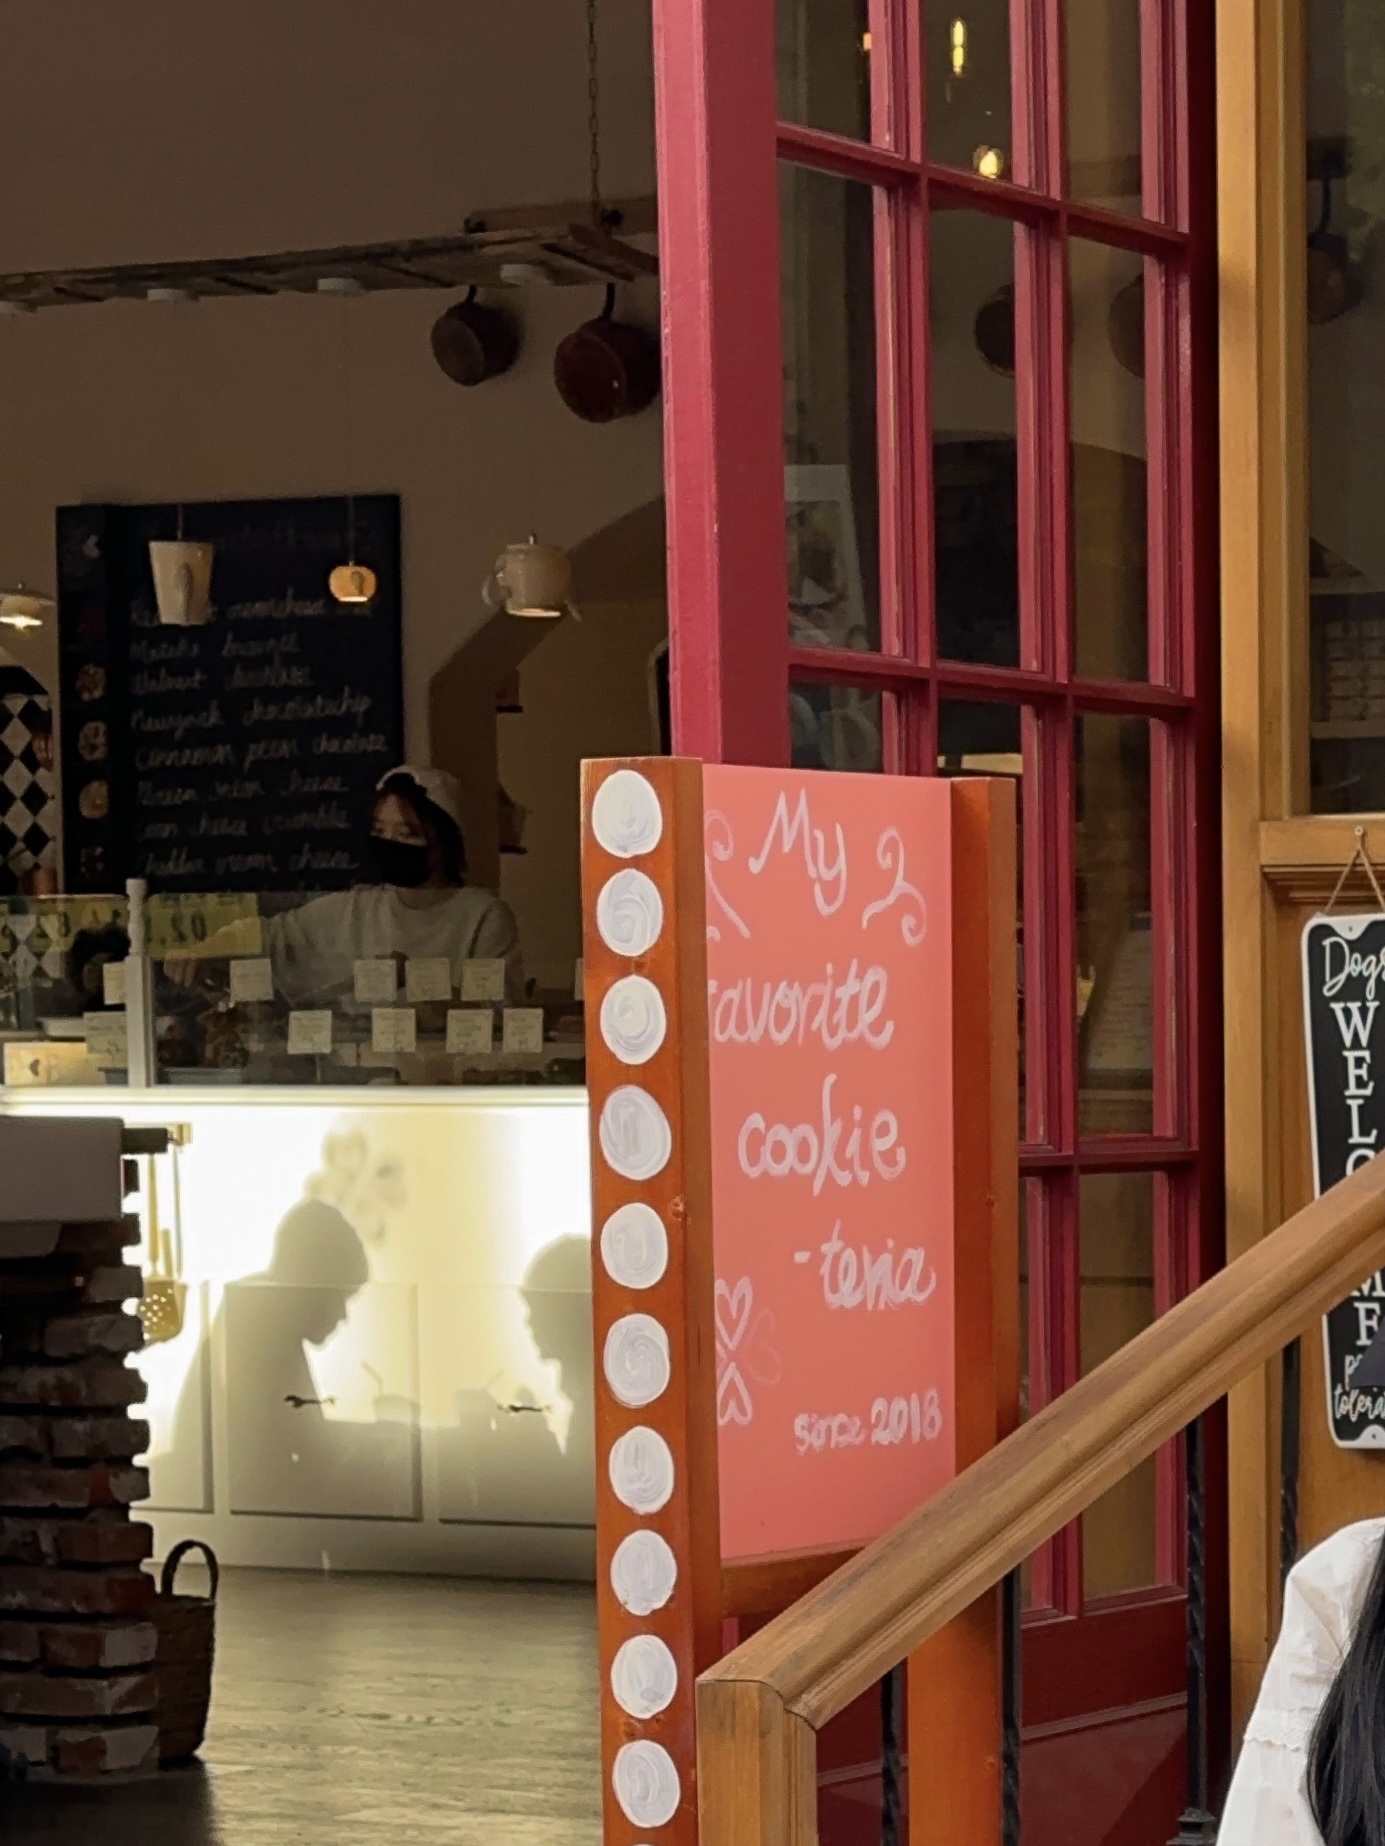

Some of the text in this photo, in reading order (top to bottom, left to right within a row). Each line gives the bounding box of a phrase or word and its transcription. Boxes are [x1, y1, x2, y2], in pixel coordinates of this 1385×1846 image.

[748, 787, 847, 918] My
[737, 1074, 907, 1196] cookie
[870, 1386, 944, 1448] 2018
